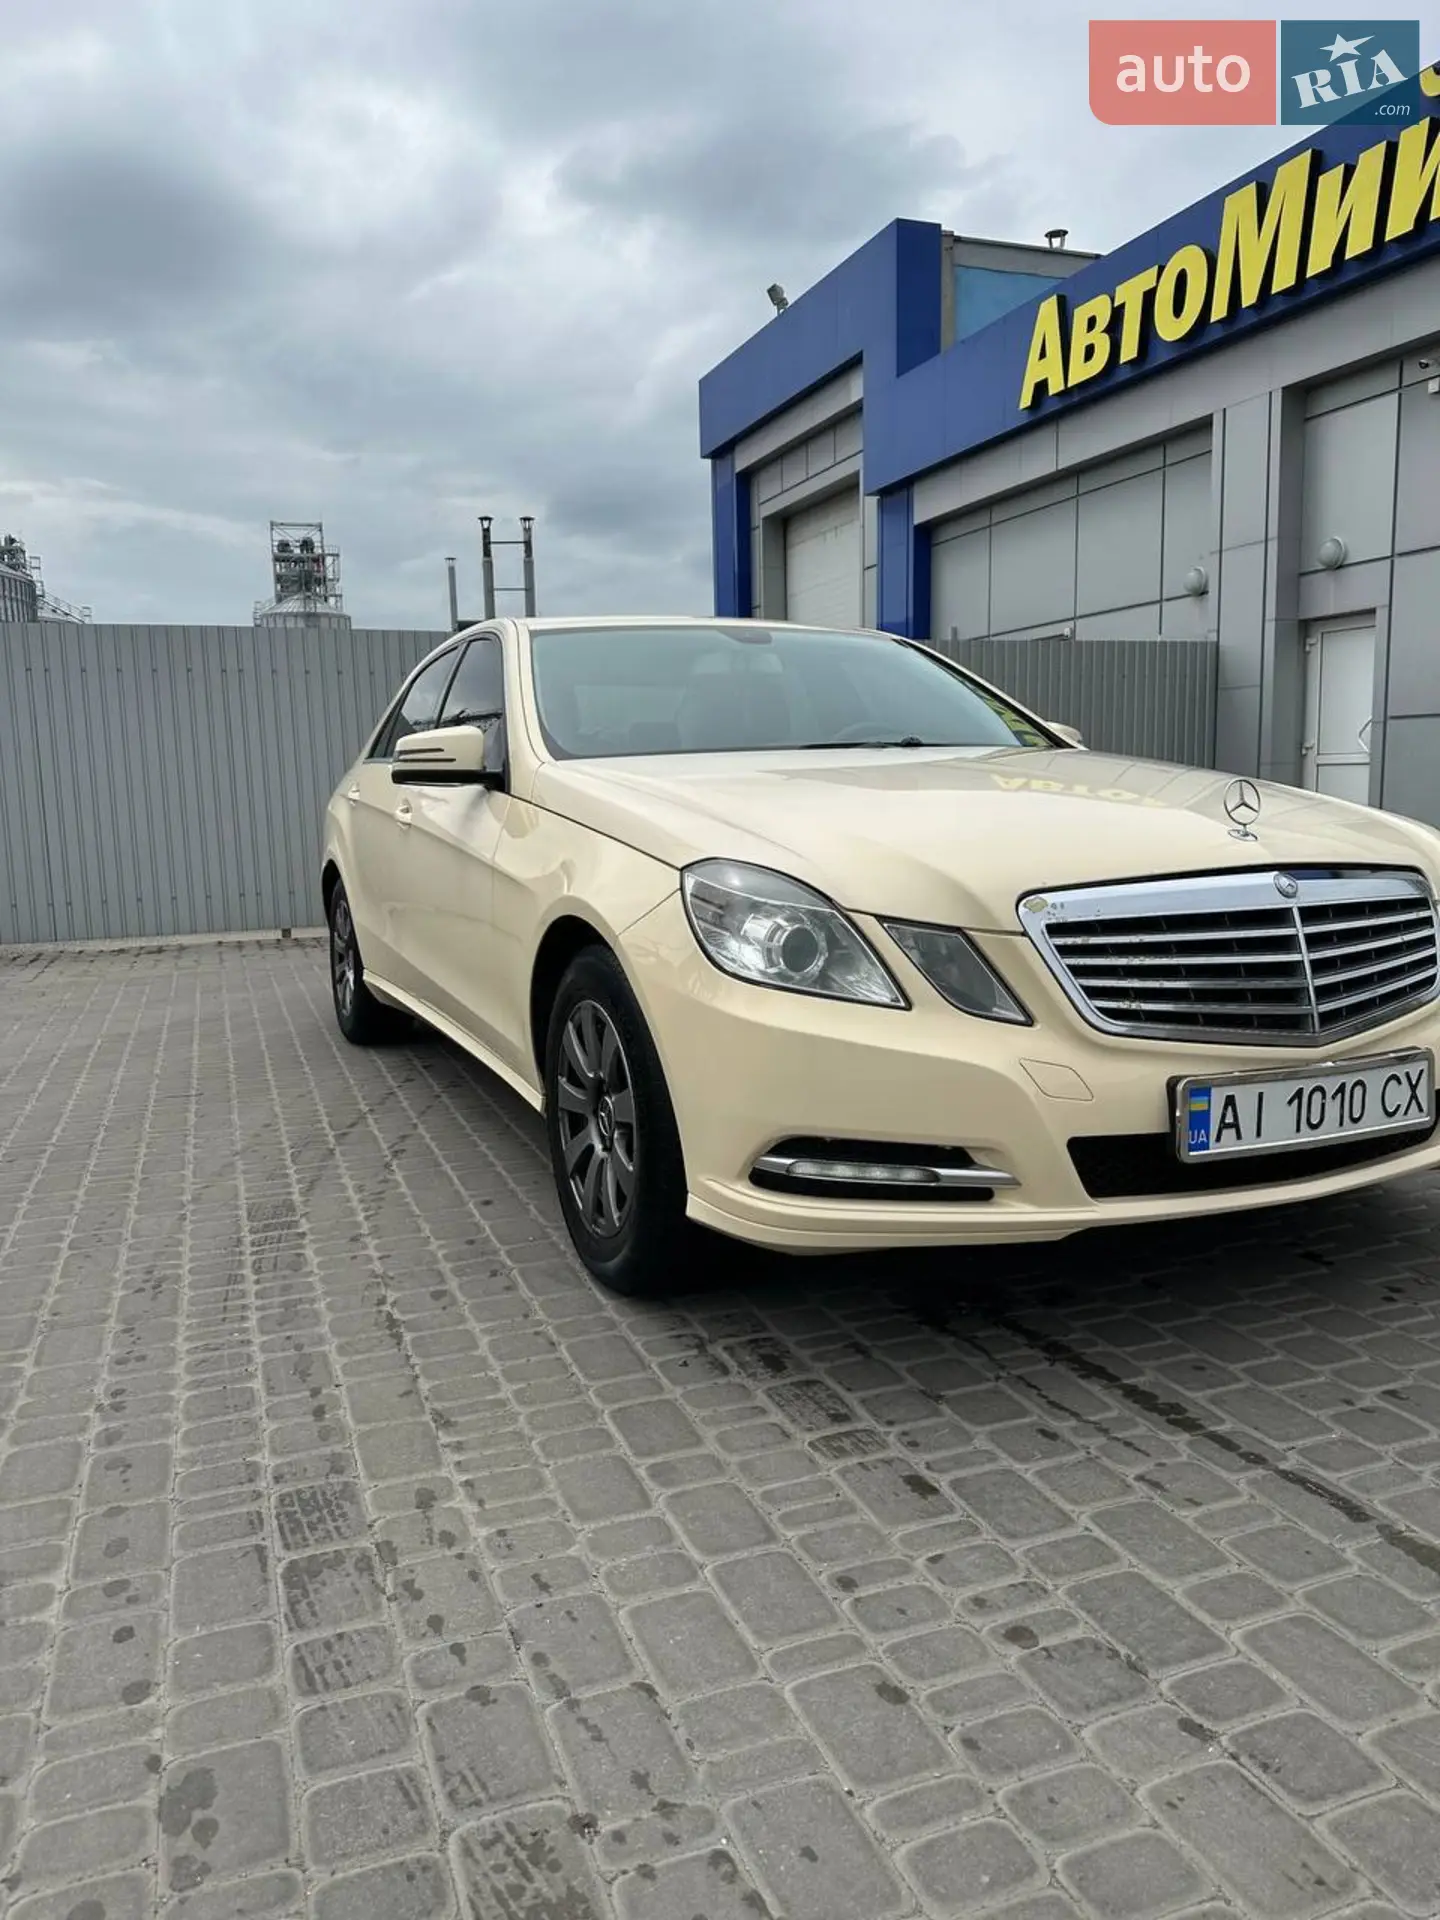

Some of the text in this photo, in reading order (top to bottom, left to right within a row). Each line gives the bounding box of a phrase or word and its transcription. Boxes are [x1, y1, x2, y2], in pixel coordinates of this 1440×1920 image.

[1215, 1068, 1425, 1143] AI 1010 CX
[1188, 1129, 1208, 1145] UA
